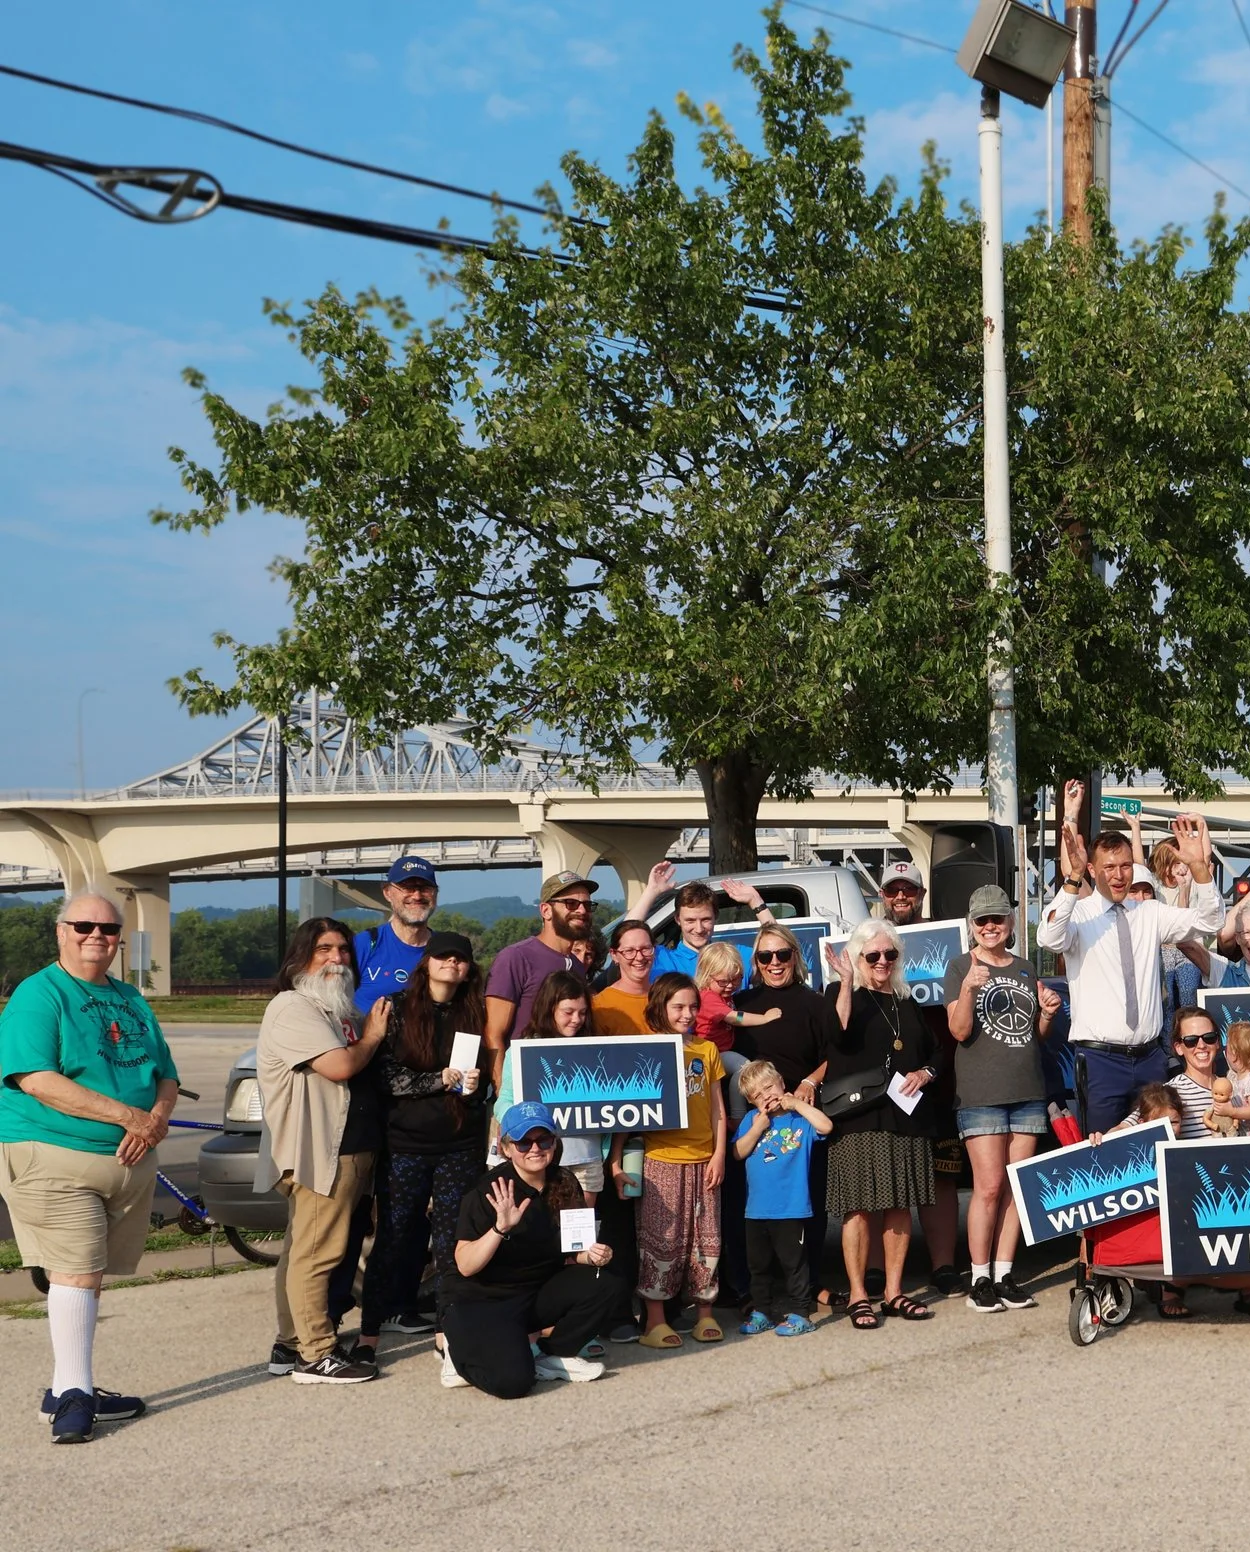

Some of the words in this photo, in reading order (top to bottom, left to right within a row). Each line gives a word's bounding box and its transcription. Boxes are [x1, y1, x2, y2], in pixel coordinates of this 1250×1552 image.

[1101, 799, 1127, 811] Second
[1130, 803, 1138, 813] St
[981, 979, 995, 992] YOU
[994, 976, 1018, 987] NEED
[976, 1012, 993, 1034] LOVE
[992, 1031, 1003, 1041] IS
[1004, 1036, 1022, 1045] ALL
[113, 1053, 150, 1068] FREEDOM
[552, 1103, 664, 1130] WILSON
[1047, 1183, 1161, 1233] WILSON
